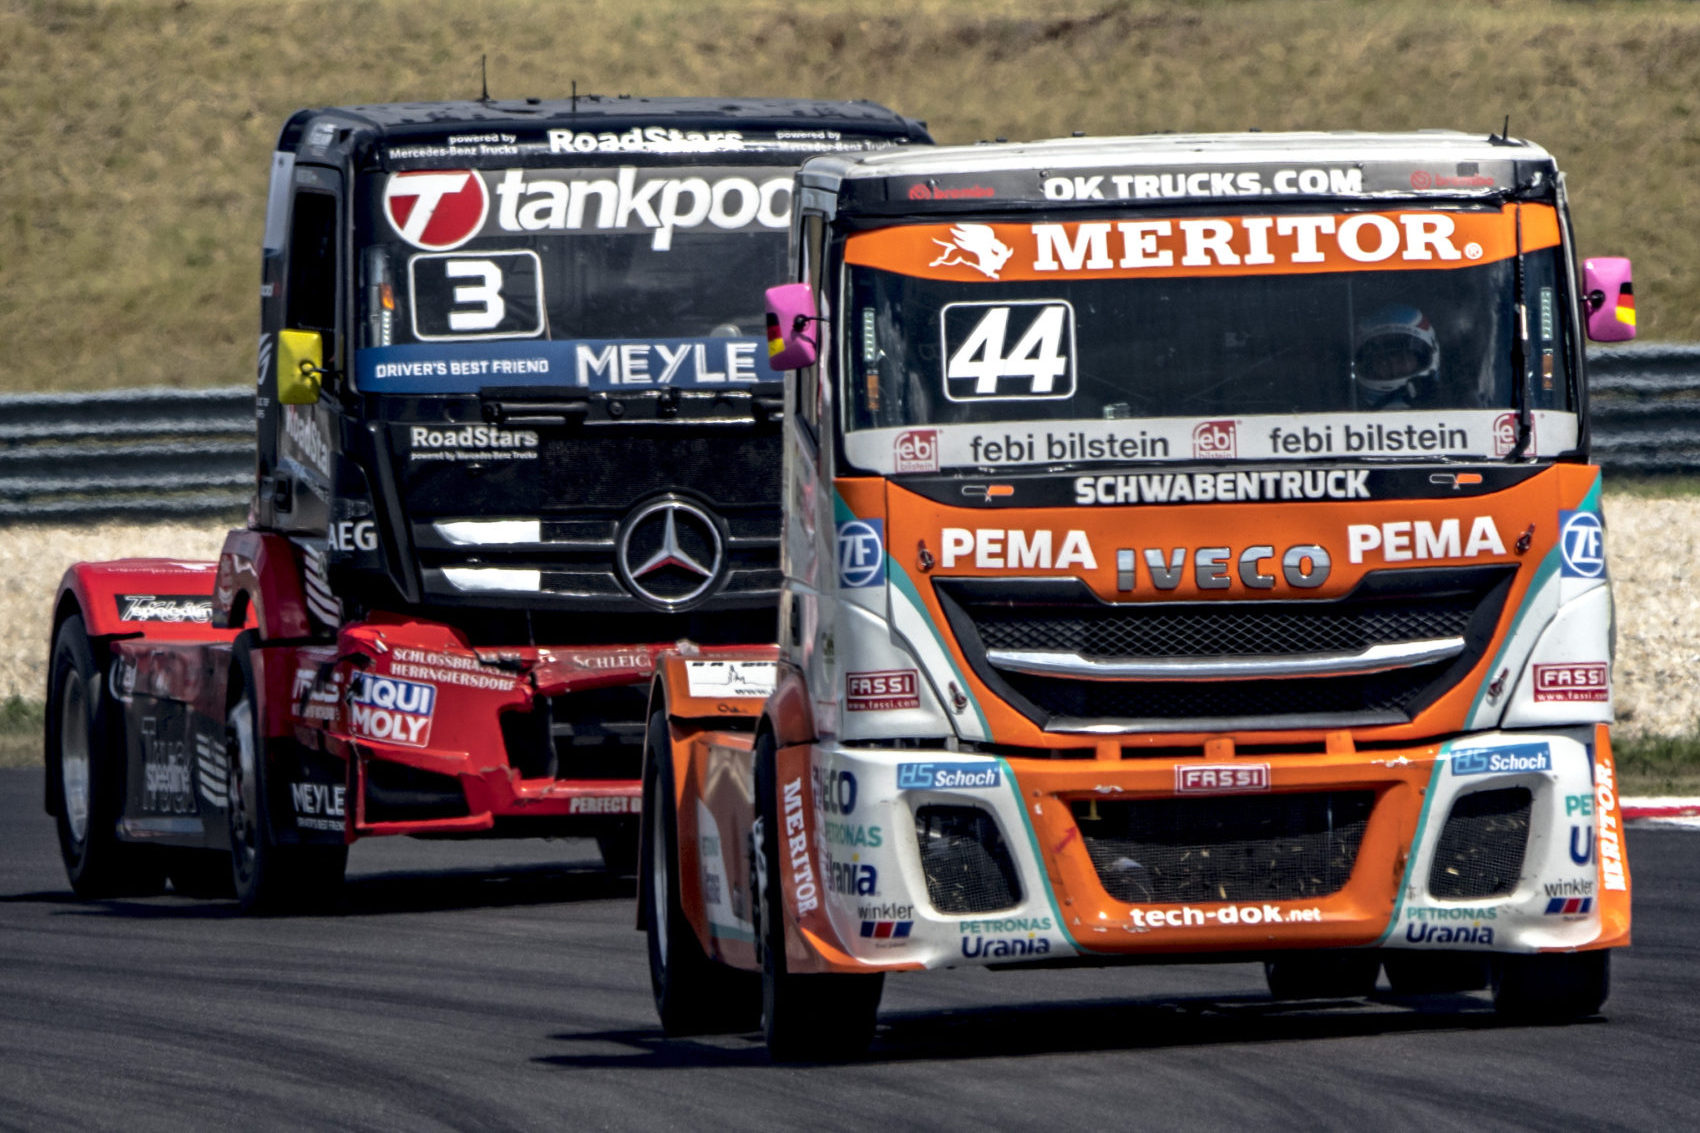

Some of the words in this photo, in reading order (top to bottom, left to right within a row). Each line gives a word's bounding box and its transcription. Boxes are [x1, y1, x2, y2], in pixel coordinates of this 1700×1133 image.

[448, 134, 499, 146] powered
[501, 133, 517, 144] by
[547, 127, 744, 153] RoadStars
[775, 131, 825, 141] powered
[827, 131, 841, 141] by
[389, 146, 477, 159] Mercedes-Benz
[480, 145, 518, 155] Trucks
[1044, 175, 1104, 201] OK
[1112, 169, 1363, 199] TRUCKS.COM
[496, 166, 793, 251] tankpoo
[446, 260, 505, 331] 3
[948, 306, 1067, 394] 44
[375, 362, 447, 379] DRIVER'S
[450, 361, 490, 375] BEST
[492, 359, 549, 374] FRIEND
[576, 343, 759, 386] MEYLE
[411, 427, 539, 448] RoadStars
[970, 434, 1034, 462] febi
[1047, 431, 1169, 461] bilstein
[1269, 426, 1332, 454] febi
[1344, 423, 1468, 451] bilstein
[1075, 469, 1370, 504] SCHWABENTRUCK
[327, 521, 378, 551] AEG
[941, 528, 1098, 569] PEMA
[1347, 516, 1507, 564] PEMA
[1117, 545, 1331, 592] IVECO
[851, 676, 911, 695] FASSI
[1544, 669, 1604, 686] FASSI
[352, 704, 428, 742] MOLY
[1489, 752, 1547, 771] Schoch
[935, 768, 996, 787] Schoch
[1186, 770, 1259, 788] FASSI
[784, 777, 818, 918] MERITOR
[1544, 878, 1594, 898] winkler
[858, 902, 915, 920] winkler
[1130, 904, 1321, 927] tech-dok.net
[1406, 906, 1498, 921] PETRONAS
[960, 917, 1052, 934] PETRONAS
[1406, 921, 1495, 945] Urania
[961, 931, 1050, 959] Urania
